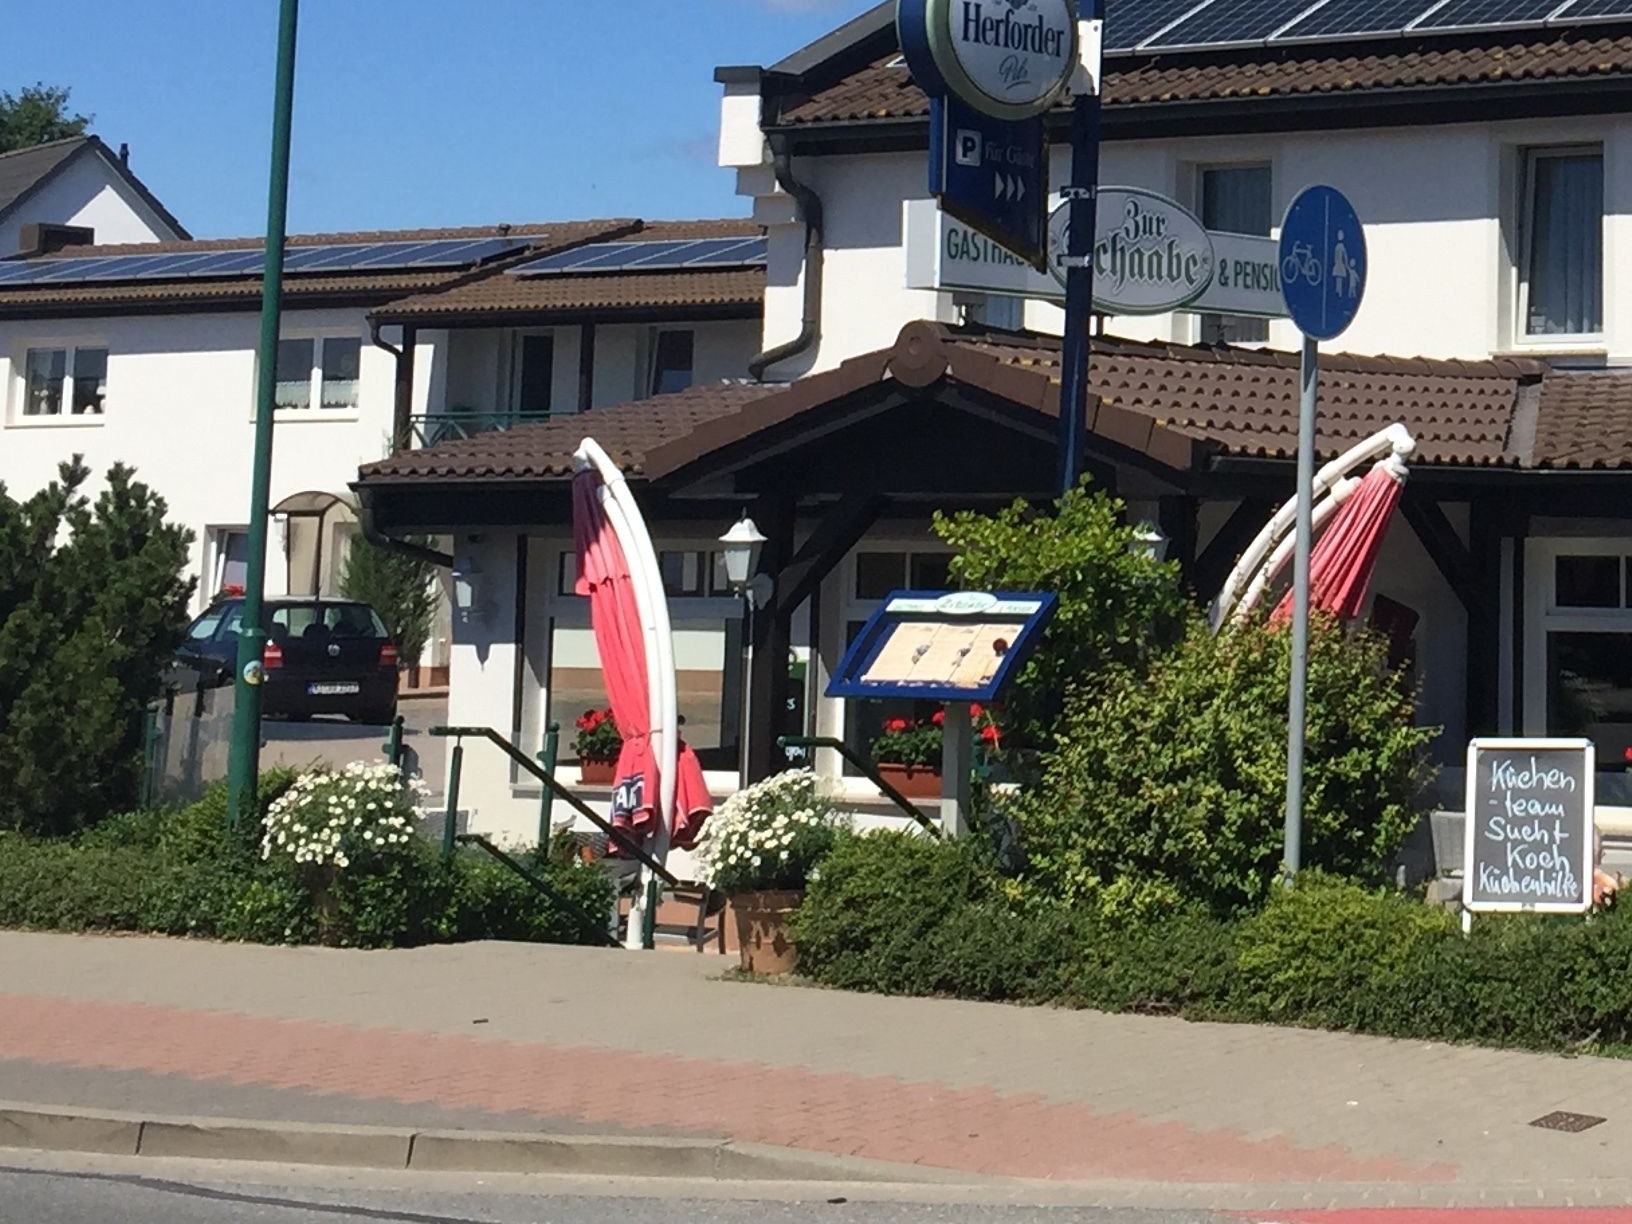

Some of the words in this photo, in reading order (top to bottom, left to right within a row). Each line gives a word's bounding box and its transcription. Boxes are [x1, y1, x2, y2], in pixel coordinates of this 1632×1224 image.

[962, 1, 1065, 58] Herforder
[962, 136, 976, 159] P
[1124, 199, 1166, 241] Zur
[946, 228, 1032, 267] GASTH
[1219, 257, 1229, 287] &
[1234, 260, 1281, 292] PENSI
[1062, 223, 1199, 291] chaabe
[1488, 756, 1576, 793] Küchen
[1506, 841, 1571, 876] Koch
[1478, 861, 1578, 898] Küchenhilfe
